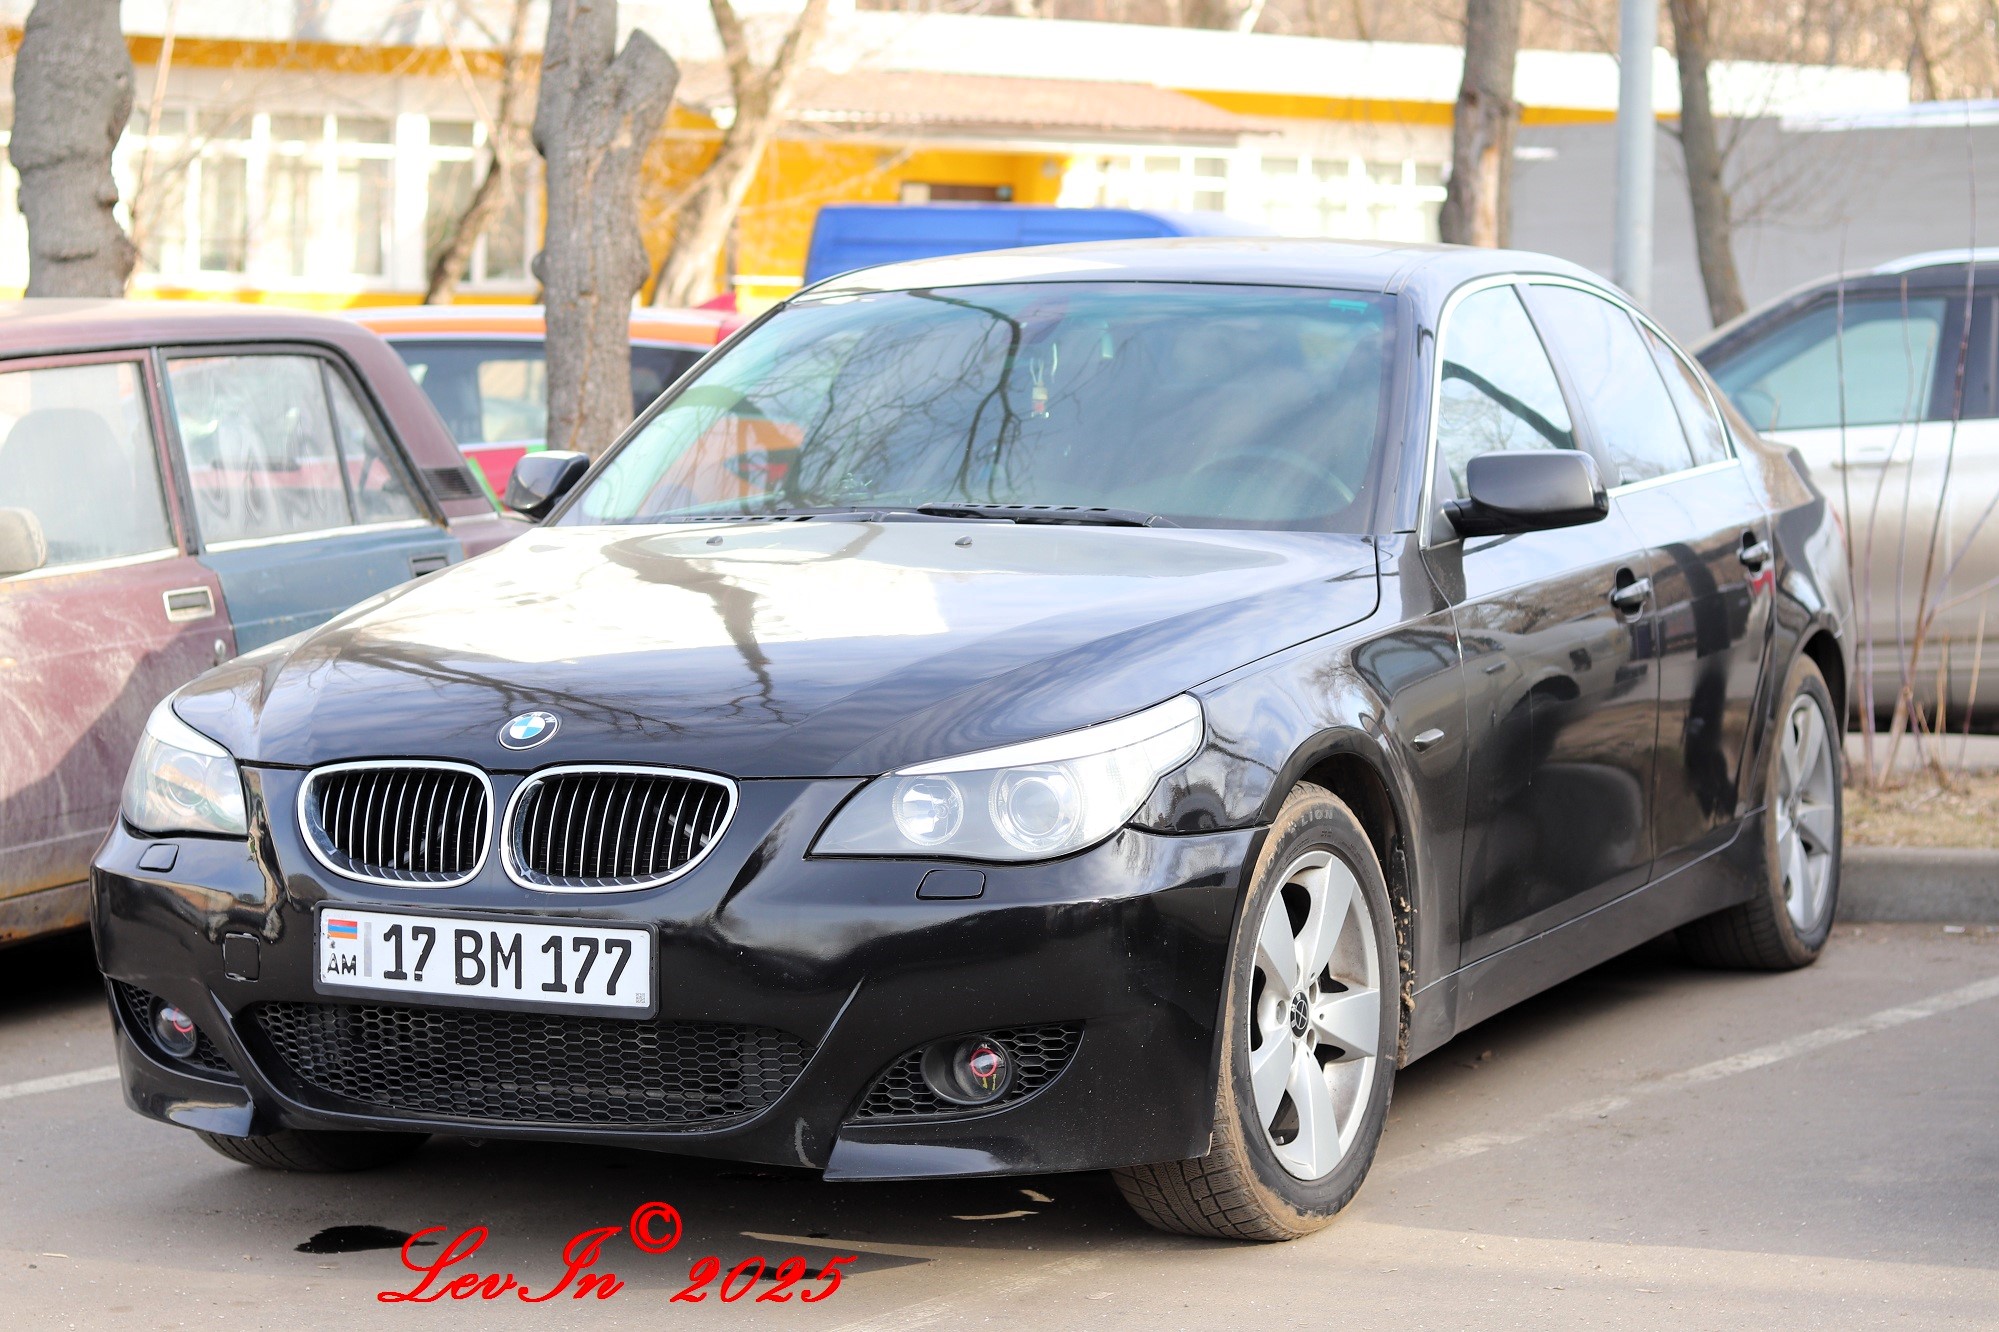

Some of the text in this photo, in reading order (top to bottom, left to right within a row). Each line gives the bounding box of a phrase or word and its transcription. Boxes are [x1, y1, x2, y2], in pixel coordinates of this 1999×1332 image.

[326, 952, 357, 976] AM
[384, 924, 632, 996] 17 BM 177
